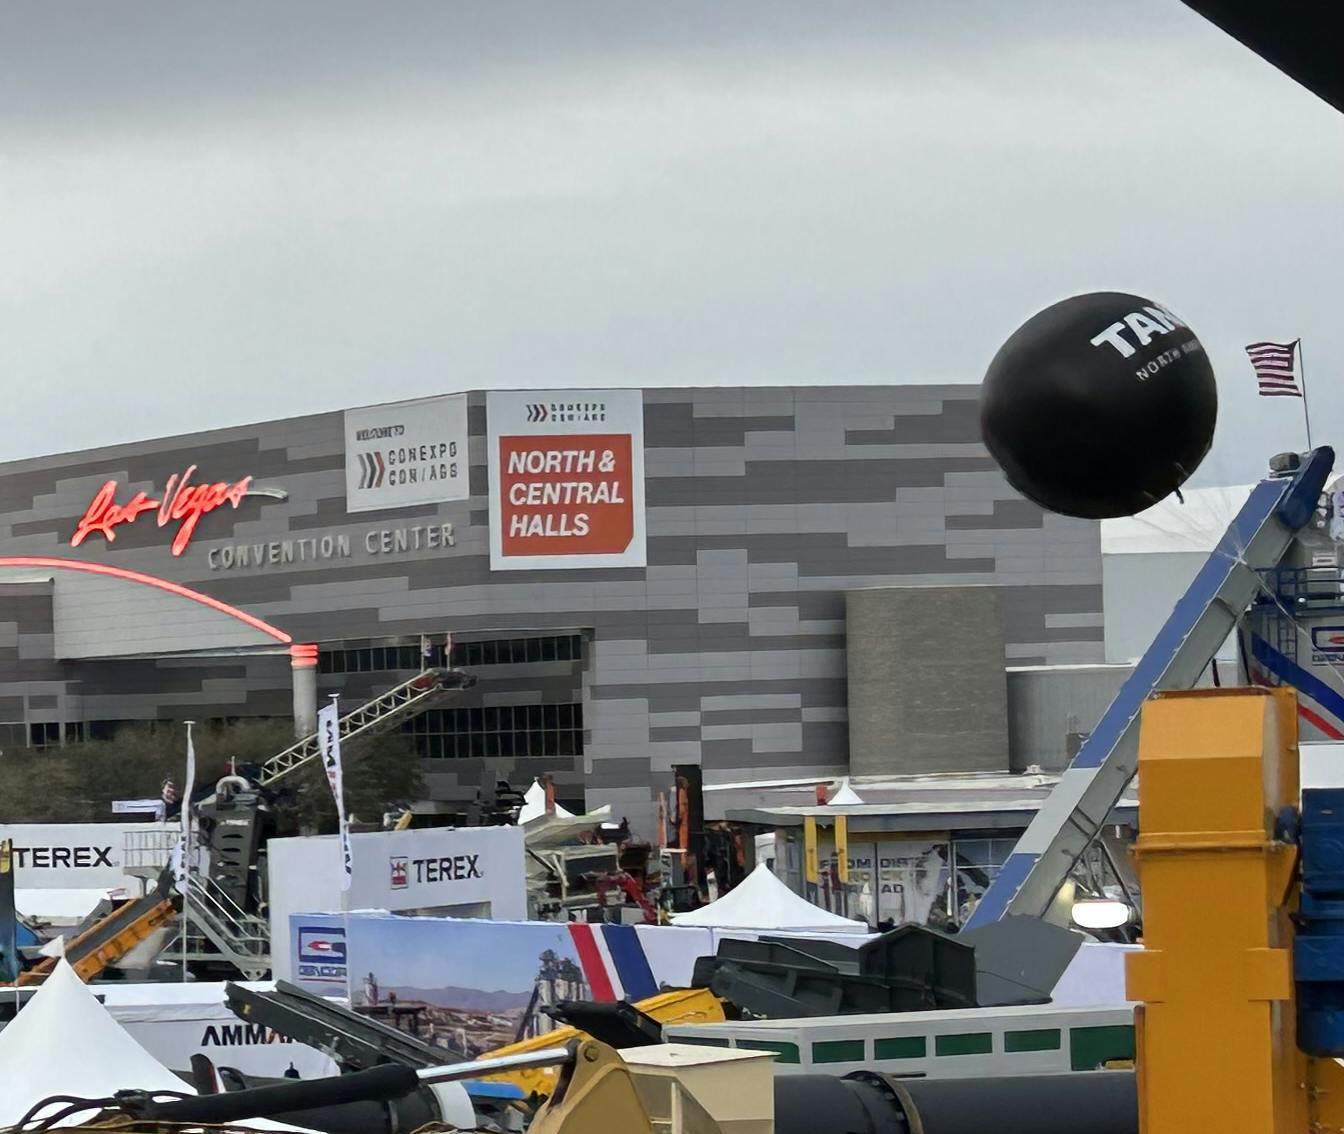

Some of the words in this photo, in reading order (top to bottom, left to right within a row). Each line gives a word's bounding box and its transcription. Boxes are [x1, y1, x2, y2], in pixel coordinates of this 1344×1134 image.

[388, 441, 457, 465] CONEXPO
[508, 450, 595, 474] NORTH
[598, 449, 616, 472] &
[509, 481, 624, 506] CENTRAL
[70, 480, 160, 547] Las
[157, 464, 288, 557] Vegas
[509, 513, 590, 537] HALLS
[208, 534, 351, 569] CONVENTION
[365, 523, 456, 555] CENTER
[13, 847, 113, 868] TEREX
[413, 855, 481, 883] TEREX
